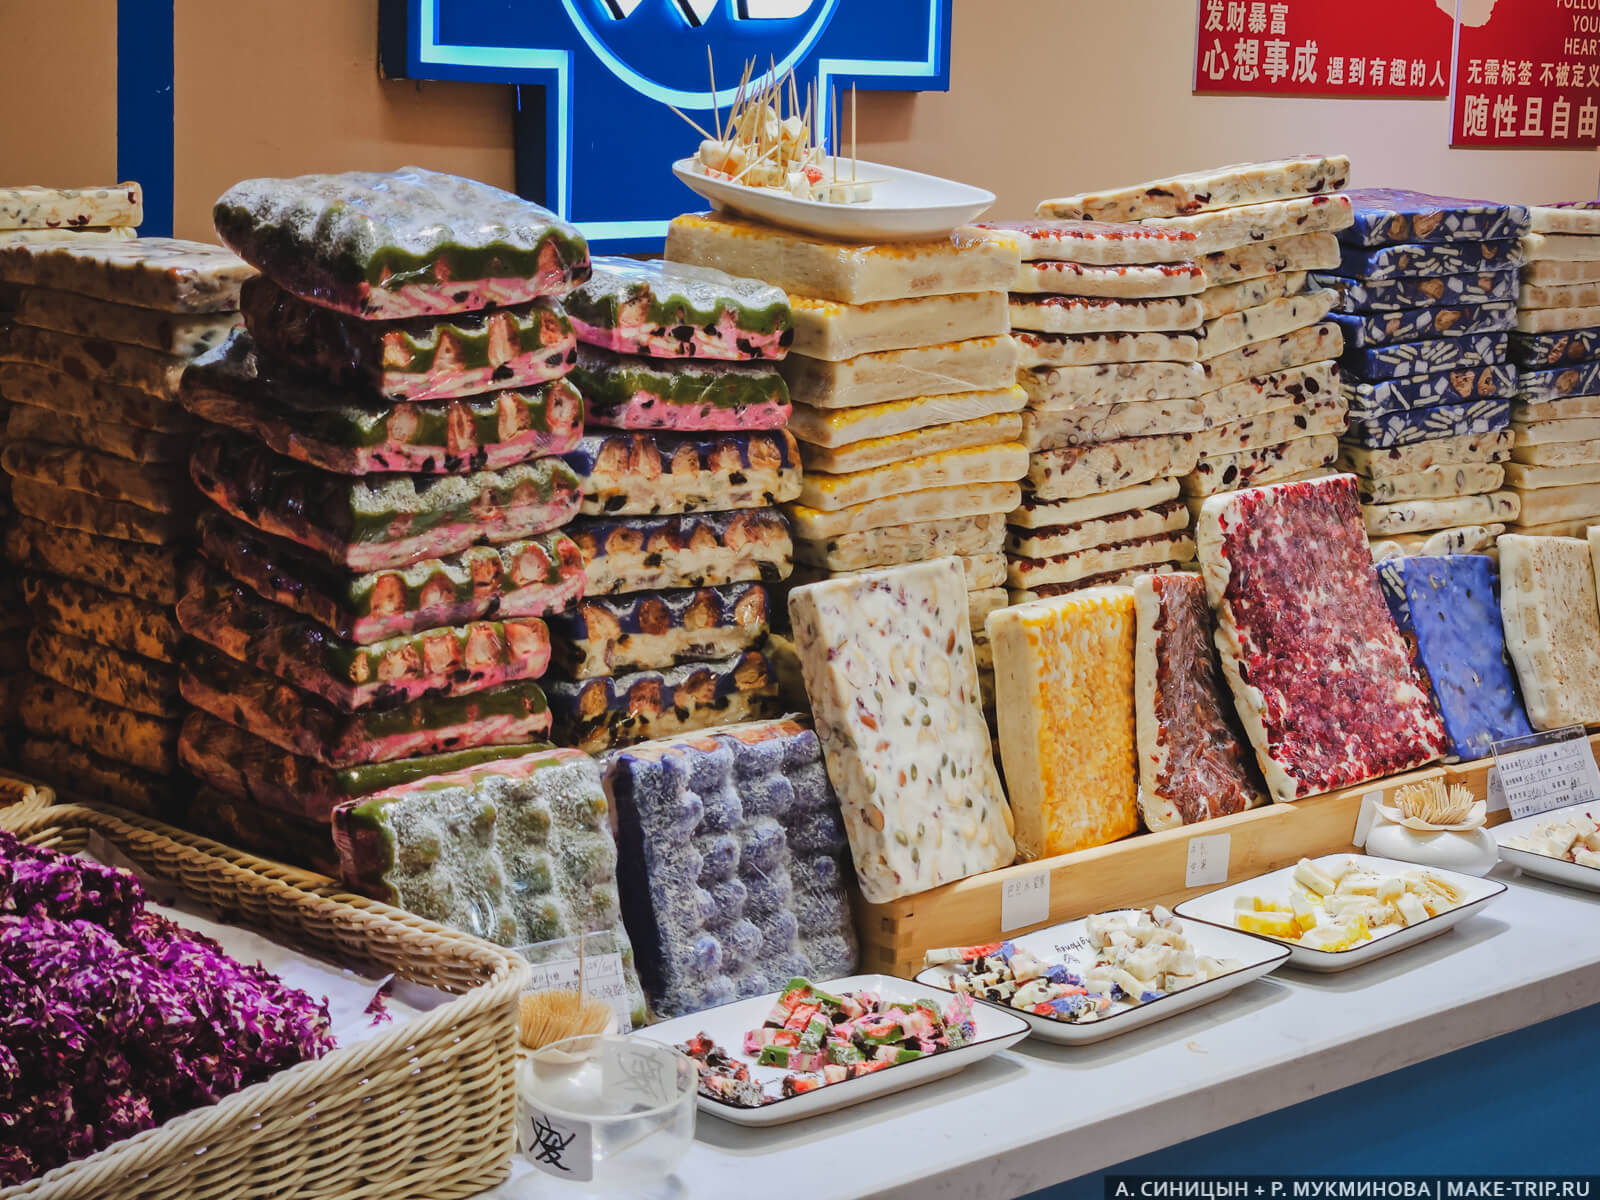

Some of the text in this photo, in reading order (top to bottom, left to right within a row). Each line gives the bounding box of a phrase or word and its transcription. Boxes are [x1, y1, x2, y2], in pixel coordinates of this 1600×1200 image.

[1204, 0, 1289, 35] 发财暴富
[1572, 15, 1600, 33] YOU
[1202, 37, 1445, 87] 心想事成 遇到有趣的人
[1564, 37, 1600, 56] HEAR
[1467, 59, 1600, 88] 无需标签 不被定义
[1462, 93, 1599, 139] 随性且自由
